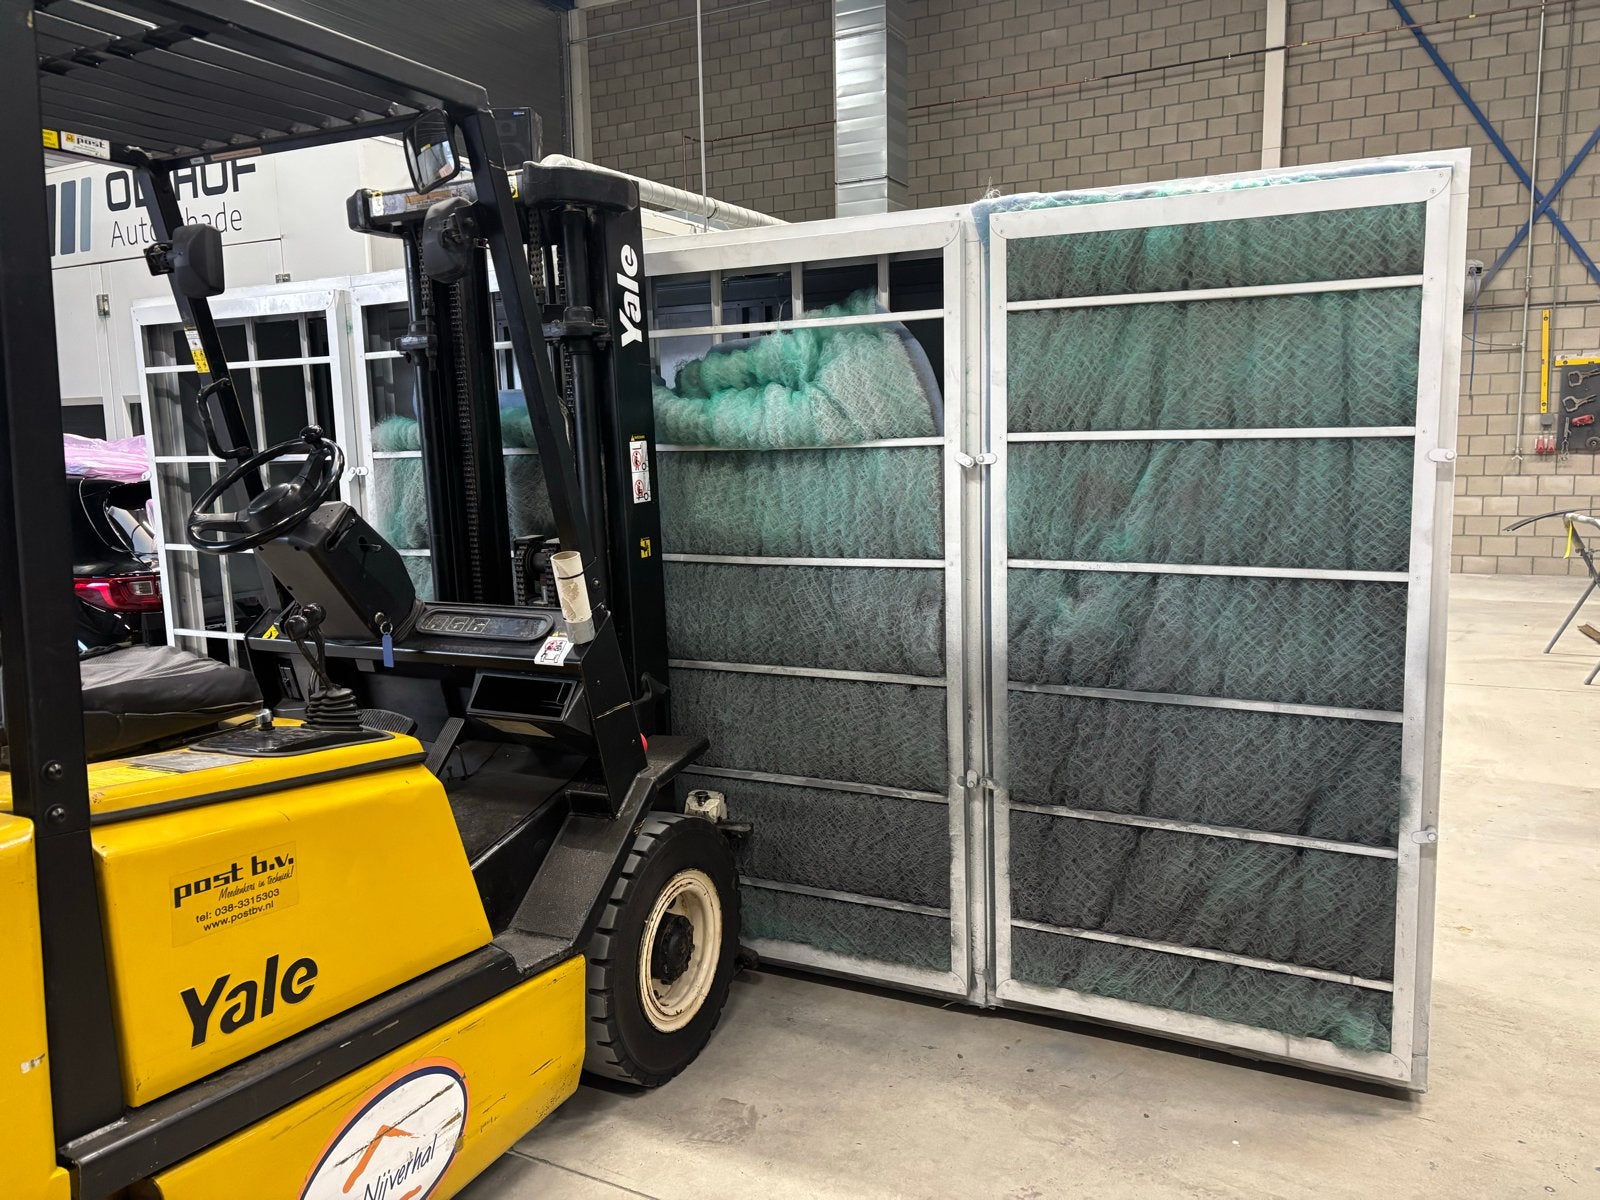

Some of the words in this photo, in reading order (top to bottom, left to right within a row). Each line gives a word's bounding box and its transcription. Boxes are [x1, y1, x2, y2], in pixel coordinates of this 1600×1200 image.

[105, 160, 257, 212] OLHOF
[617, 244, 643, 347] Yale
[174, 862, 244, 909] post
[251, 853, 294, 877] b.v.
[195, 911, 213, 923] tel:
[214, 888, 280, 917] 038-3315303
[258, 880, 266, 888] in
[203, 900, 275, 931] www.postbv.nl
[180, 953, 318, 1048] Yale
[363, 1133, 438, 1200] Nijverhal
